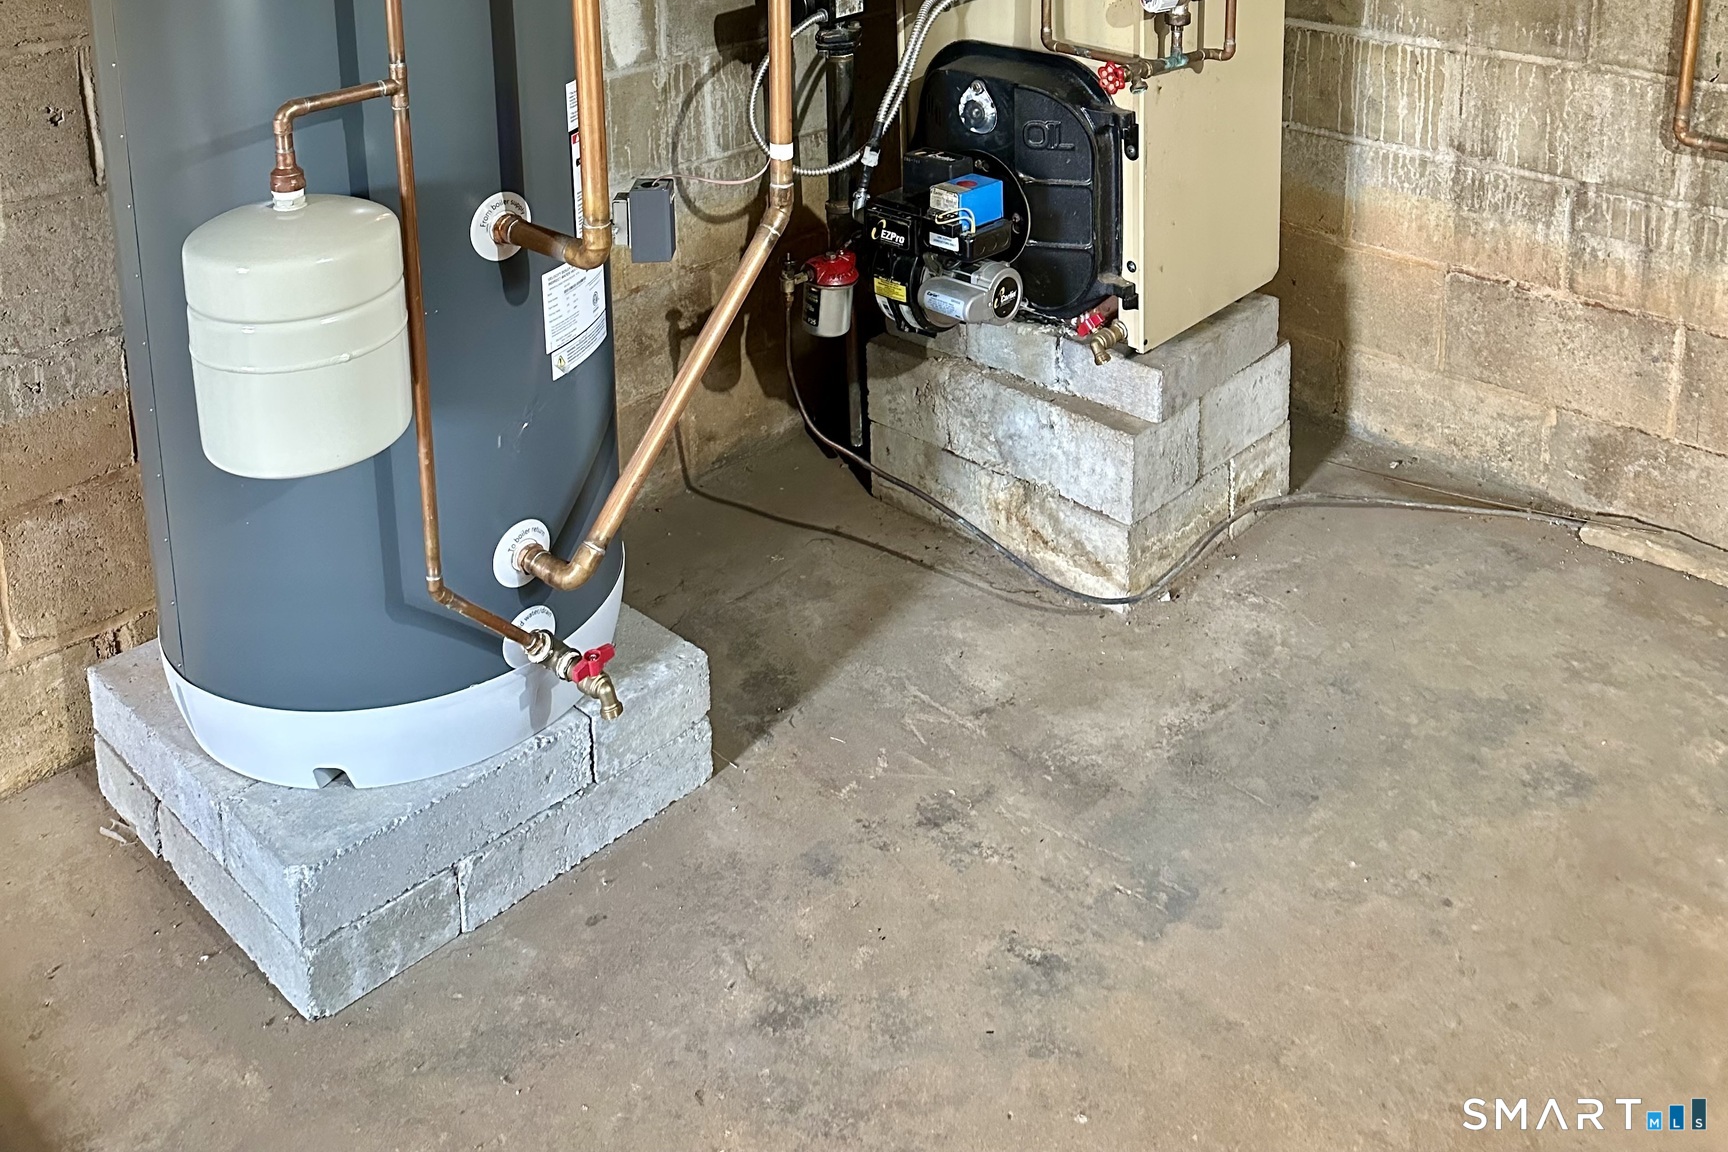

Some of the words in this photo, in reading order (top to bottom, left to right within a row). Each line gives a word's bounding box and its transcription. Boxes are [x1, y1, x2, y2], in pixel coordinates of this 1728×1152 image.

[1022, 119, 1075, 151] OIL
[480, 209, 493, 228] From
[491, 199, 510, 212] boiler
[510, 200, 525, 215] supply
[880, 230, 905, 244] EZPro
[508, 543, 517, 552] To
[514, 528, 530, 543] boiler
[531, 527, 545, 537] return
